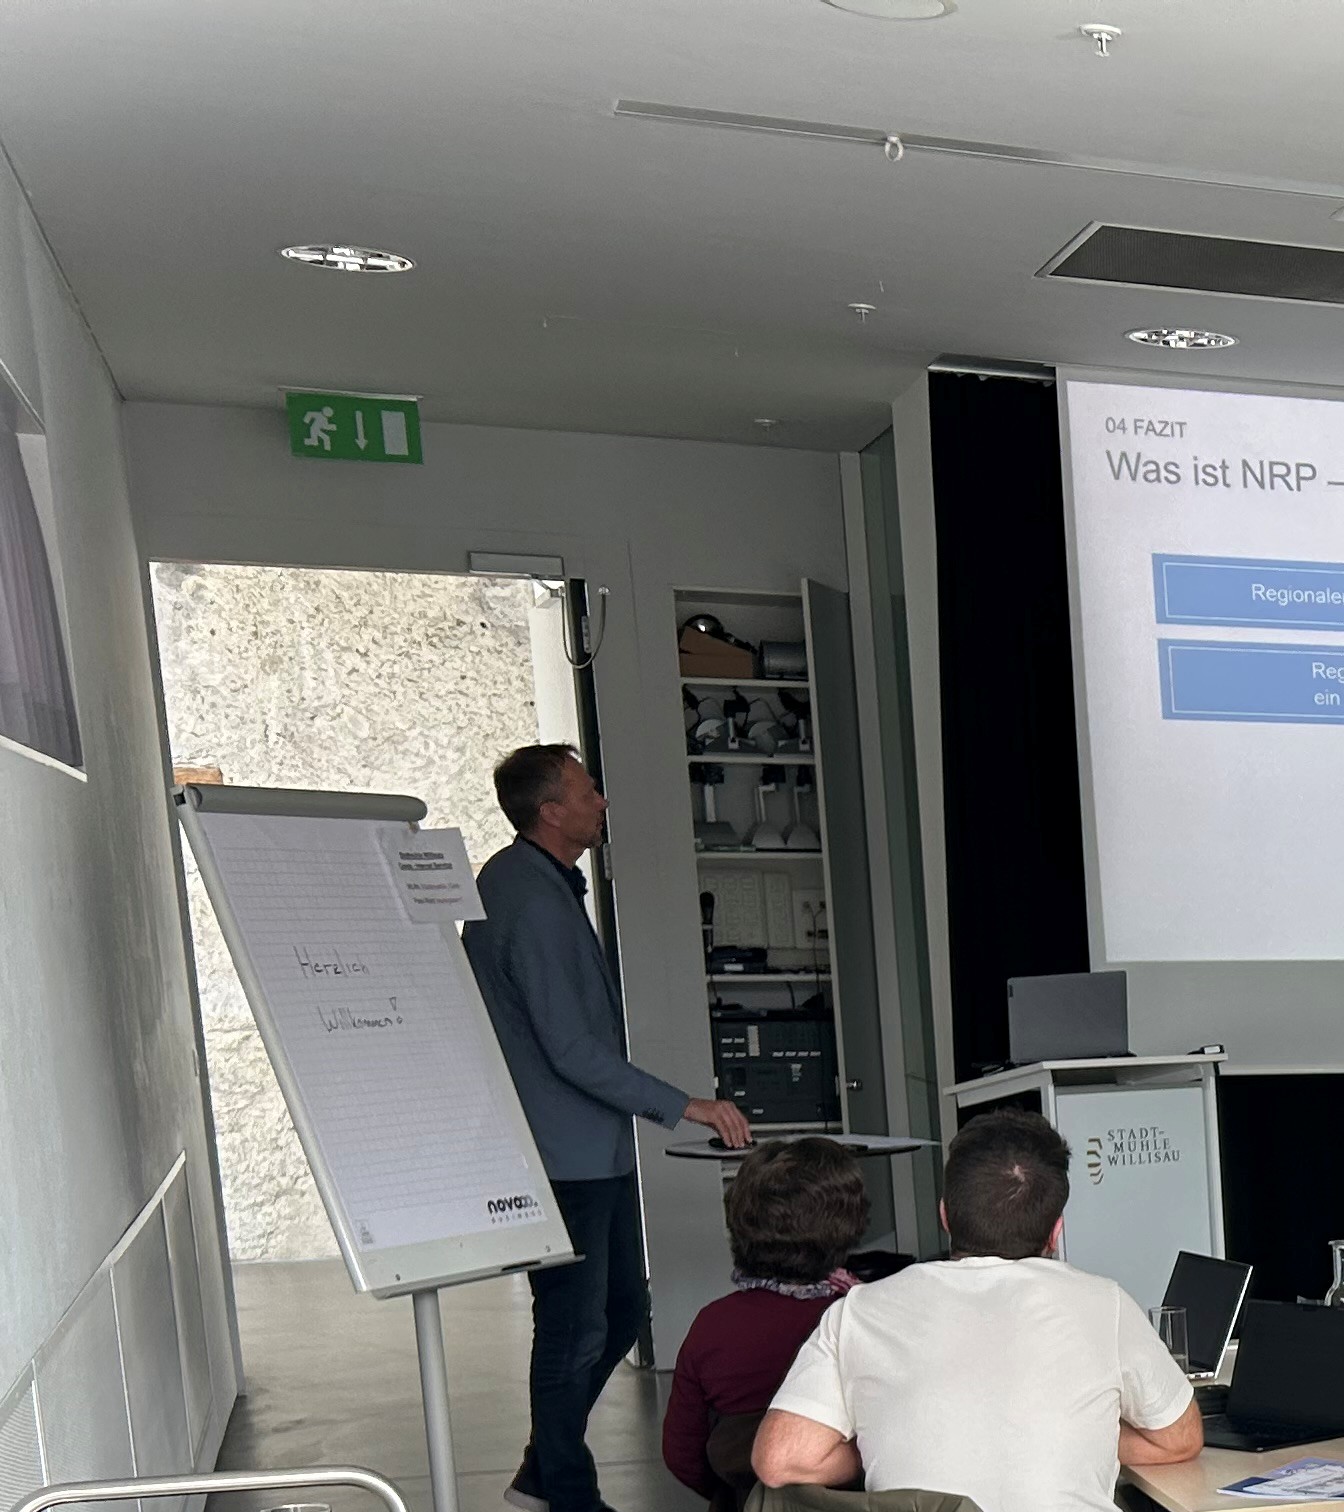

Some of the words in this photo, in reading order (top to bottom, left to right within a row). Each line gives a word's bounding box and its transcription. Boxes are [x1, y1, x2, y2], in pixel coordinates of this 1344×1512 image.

[1105, 416, 1128, 435] 04
[1133, 418, 1188, 439] FAZIT
[1105, 449, 1182, 485] Was
[1192, 455, 1232, 489] ist
[1241, 458, 1317, 493] NRP
[1313, 692, 1341, 706] ein
[1107, 1127, 1165, 1142] STADT-
[1107, 1150, 1181, 1167] WILLISAU
